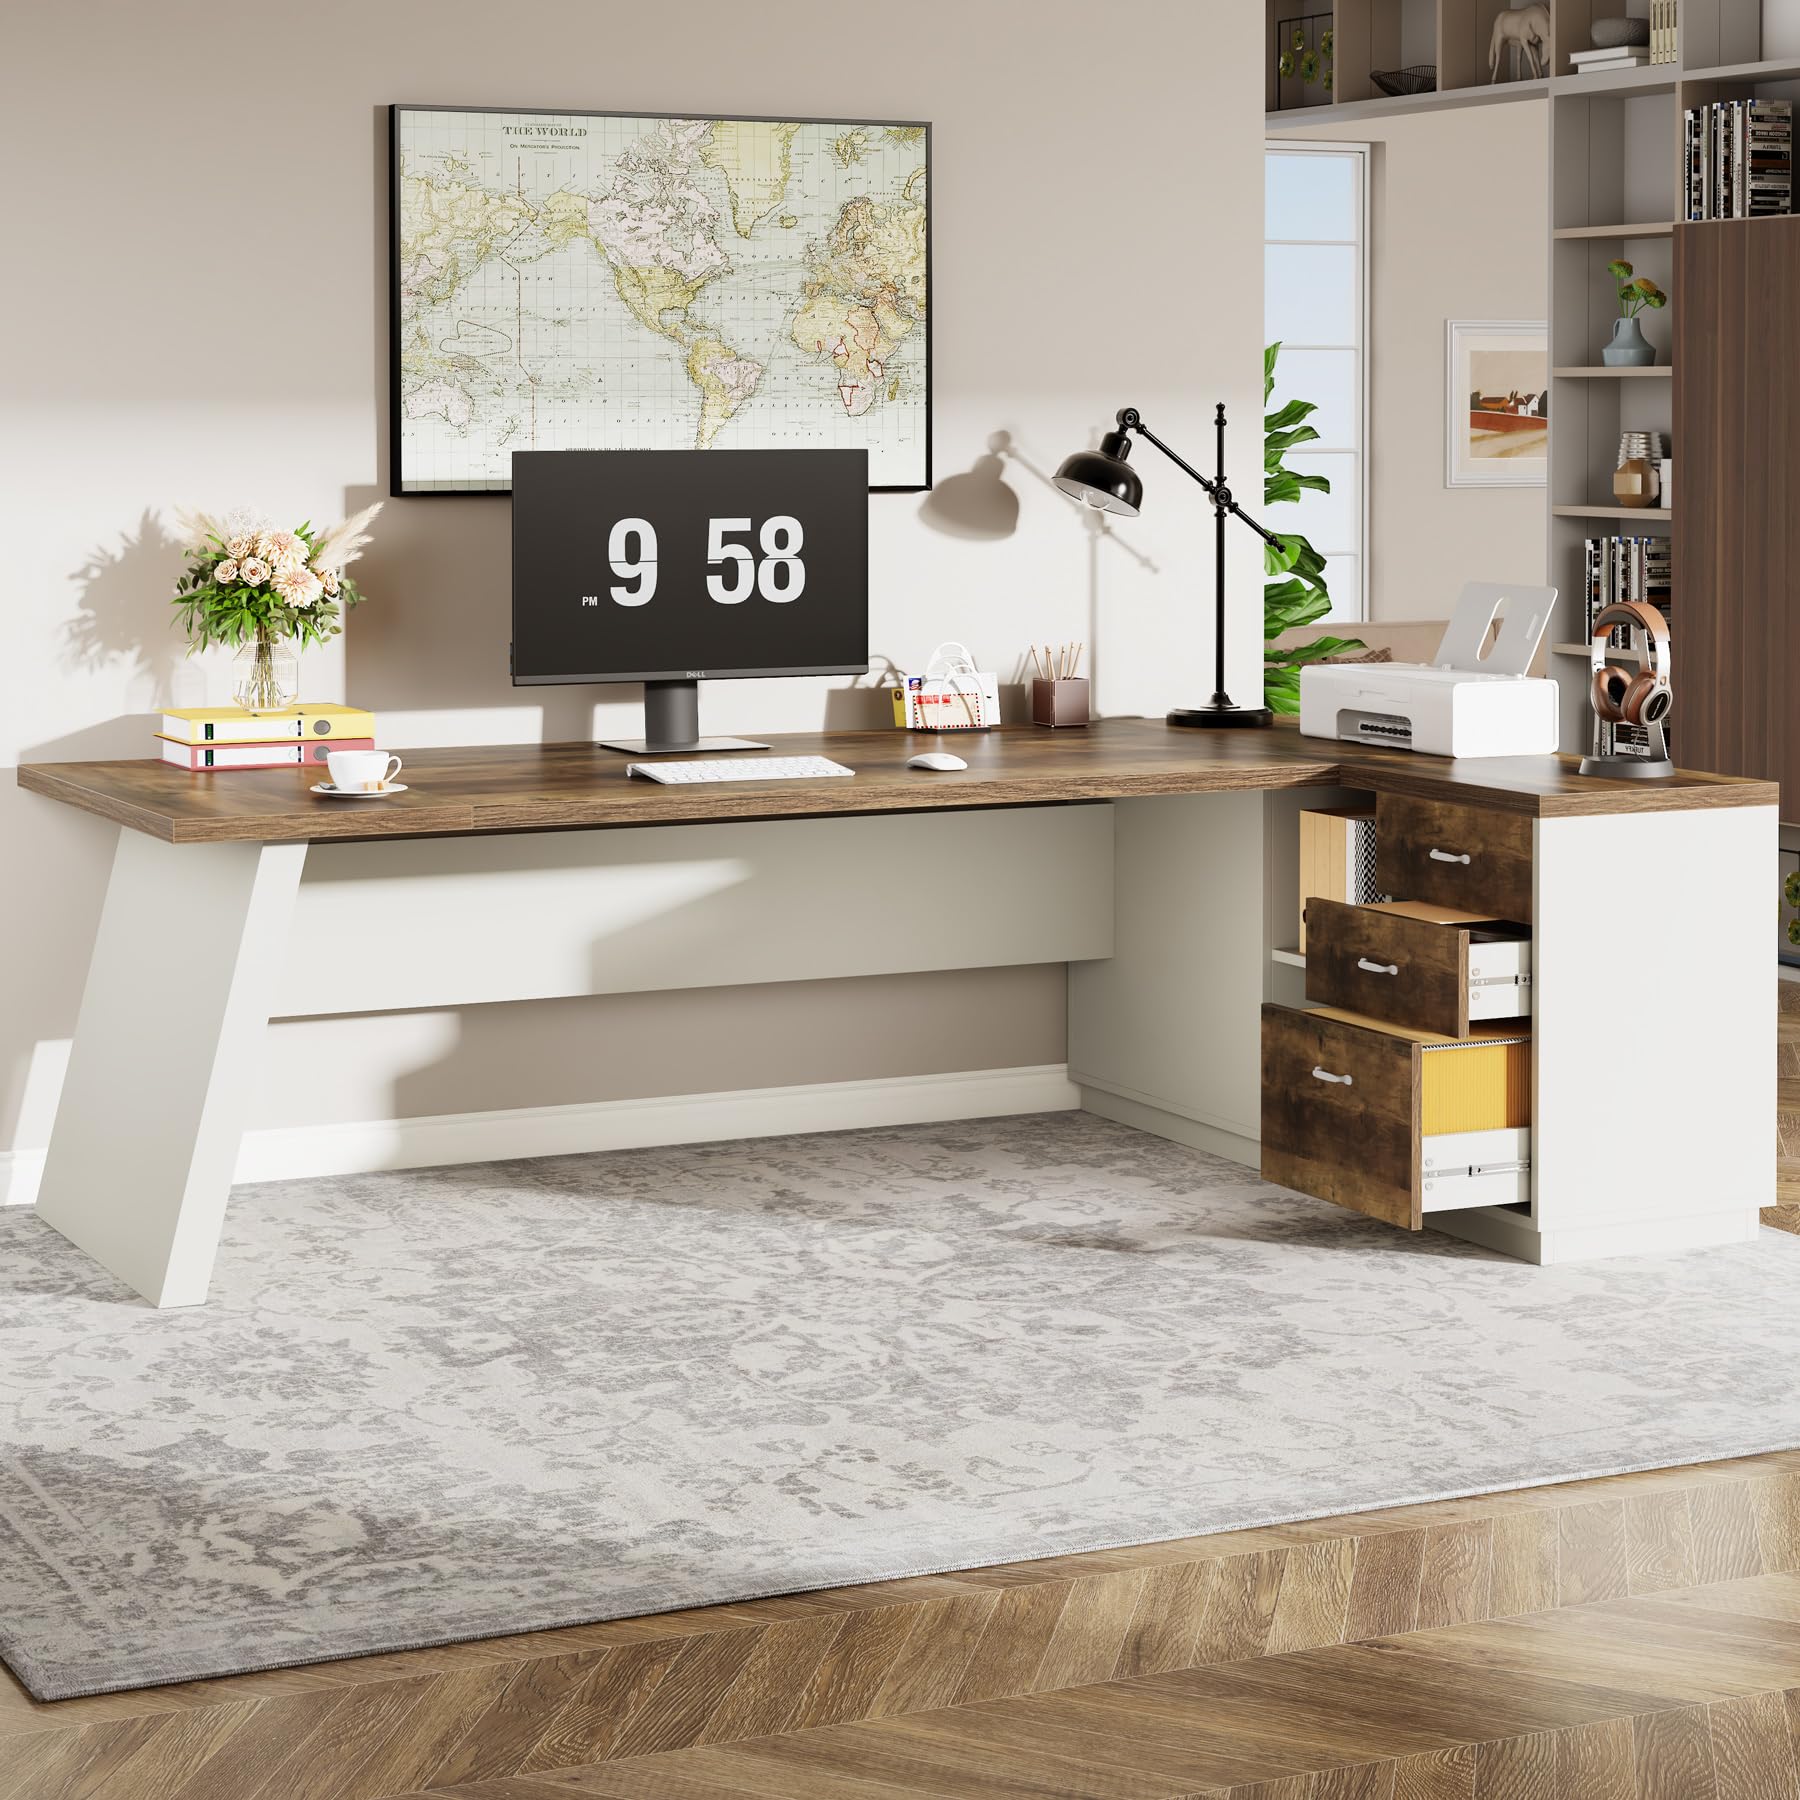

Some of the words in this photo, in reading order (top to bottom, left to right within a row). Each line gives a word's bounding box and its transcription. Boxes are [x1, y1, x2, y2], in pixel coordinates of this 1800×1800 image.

[502, 126, 533, 136] THE
[535, 127, 587, 137] WORLD
[582, 596, 598, 607] PM
[608, 517, 658, 607] 9
[706, 515, 806, 605] 58
